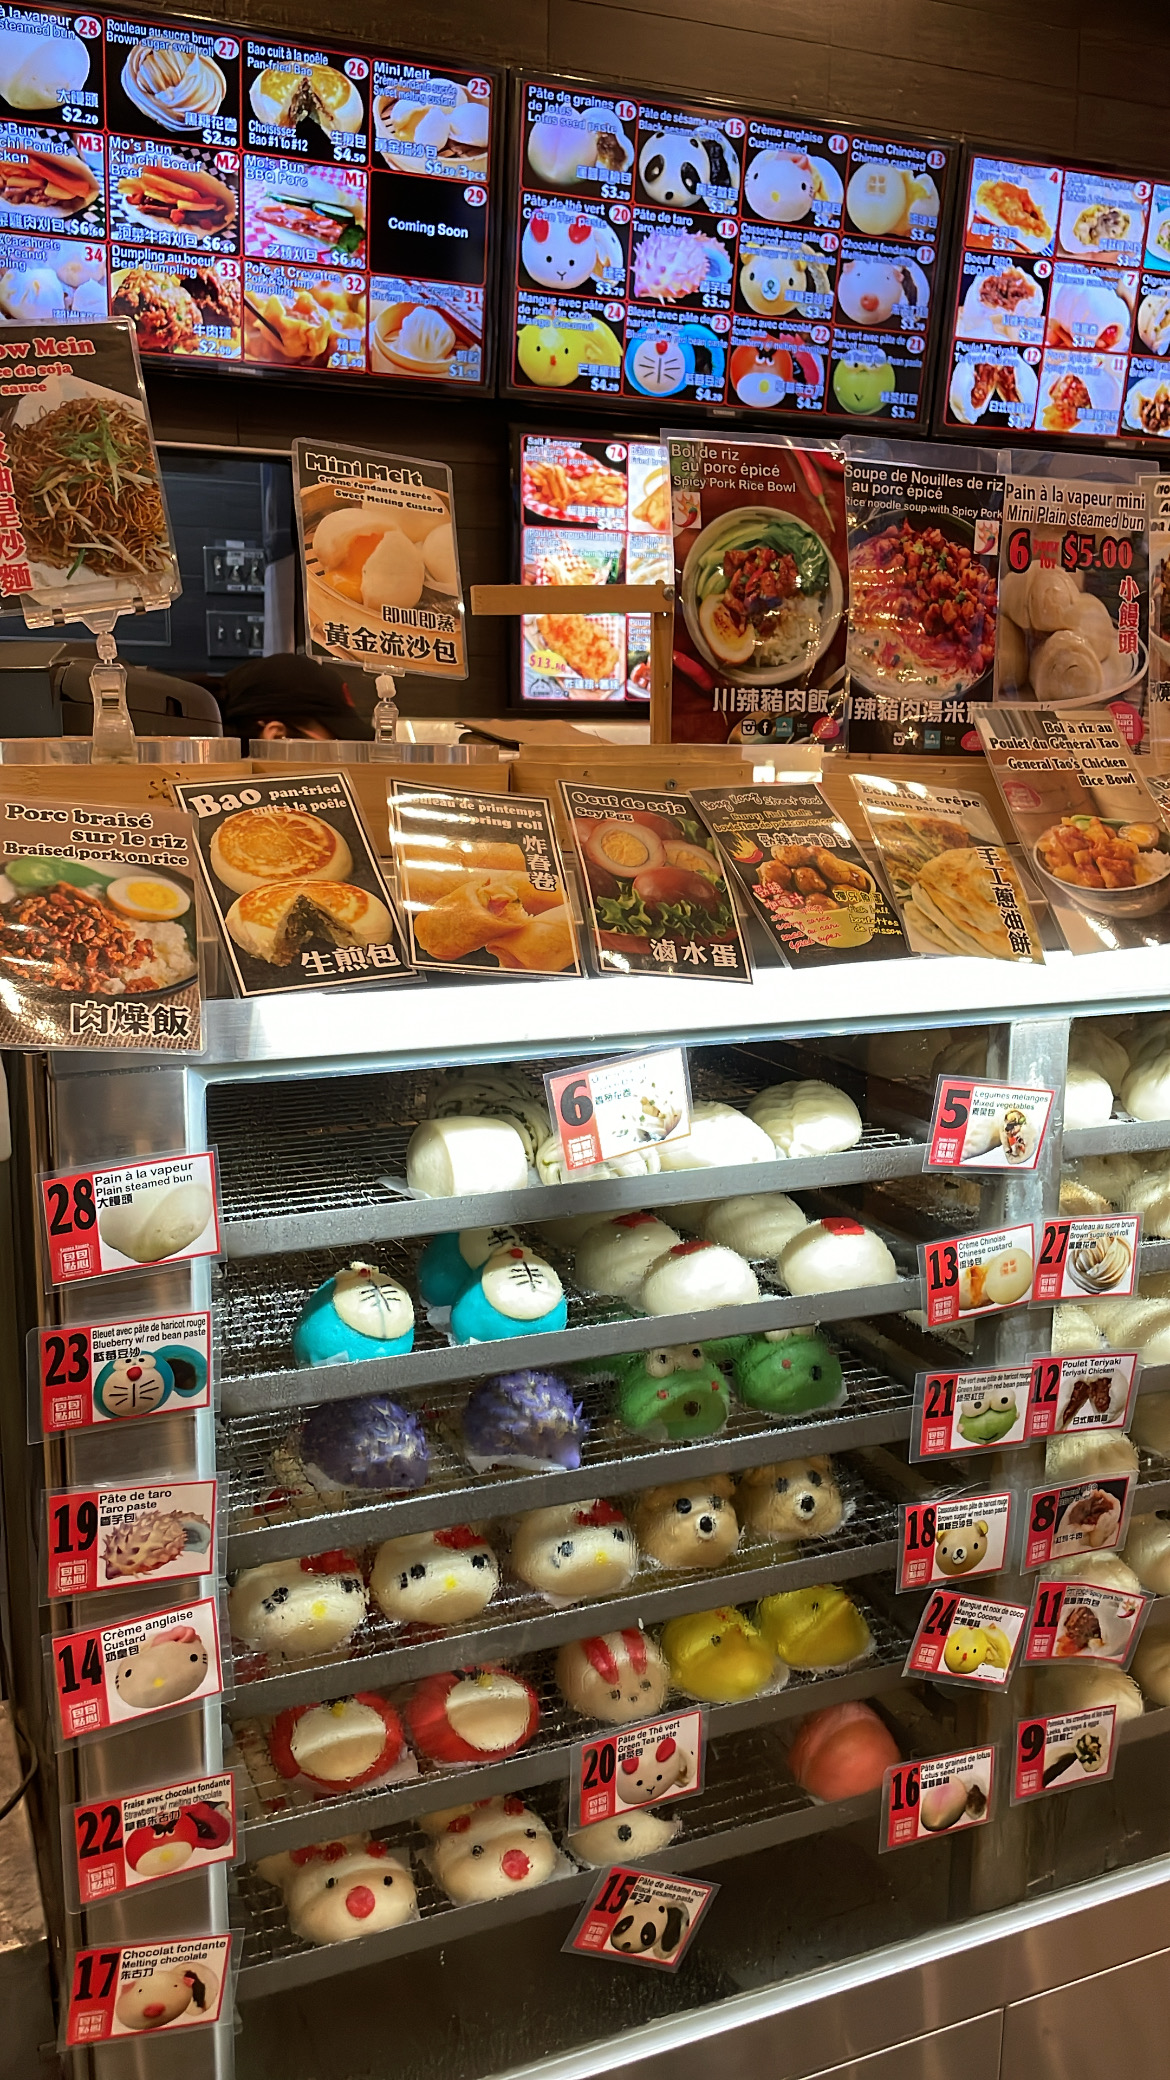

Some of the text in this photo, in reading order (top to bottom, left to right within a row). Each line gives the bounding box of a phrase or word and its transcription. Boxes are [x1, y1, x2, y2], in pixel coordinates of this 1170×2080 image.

[9, 7, 71, 28] la vapeur
[78, 19, 98, 36] 28
[107, 19, 213, 45] Rouleau au sucre brun
[218, 40, 235, 56] 27
[247, 58, 312, 76] Pan-fried Bao
[348, 62, 365, 77] 26
[374, 62, 430, 79] Mini Melt
[470, 81, 488, 95] 25
[529, 86, 614, 110] Pâte de graines
[62, 107, 98, 125] $2.20
[618, 103, 634, 118] 16
[202, 130, 237, 146] $2.50
[249, 120, 296, 138] Choisissez
[750, 123, 823, 144] Crème anglaise
[78, 135, 103, 152] M3
[109, 136, 172, 154] Mo's Bun
[832, 137, 845, 151] 14
[110, 151, 201, 172] Kimchi Boeuf
[216, 156, 239, 170] M2
[334, 147, 365, 163] $4.50
[929, 153, 943, 167] 13
[111, 165, 143, 177] Beef
[345, 172, 365, 187] M1
[467, 188, 483, 203] 29
[612, 207, 628, 222] 20
[388, 217, 469, 238] Coming Soon
[721, 221, 736, 237] 19
[85, 247, 103, 261] 34
[220, 262, 237, 277] 33
[346, 277, 362, 291] 32
[465, 290, 480, 304] 31
[607, 305, 621, 319] 24
[714, 317, 728, 331] 23
[814, 328, 828, 341] 22
[34, 337, 96, 356] Mein
[1, 382, 47, 394] sauce
[672, 444, 740, 461] Bol de riz
[305, 452, 423, 487] Mini Melt
[319, 475, 432, 501] Crème fondante sucrée
[674, 476, 796, 493] Spicy Pork Rice Bowl
[335, 489, 443, 514] Sweet Melting Custard
[867, 498, 1003, 519] noodle soup with Spicy Pork
[1007, 505, 1144, 531] Mini Plain steamed bun
[1008, 528, 1133, 573] 6 $5.00
[713, 687, 831, 714] 川辣豬肉飯
[1079, 773, 1135, 786] Rice Bowl
[188, 783, 342, 819] Bao pan-fried
[572, 792, 686, 815] Oeuf de soja
[866, 798, 962, 815] Scallion pancake
[936, 796, 980, 808] crêpe
[5, 803, 153, 829] Porc braisé
[575, 807, 634, 822] Soy Egg
[71, 830, 187, 850] sur le riz
[5, 842, 188, 866] Braised pork on rice
[522, 835, 558, 892] 炸春卷
[300, 943, 401, 977] 生煎包
[650, 938, 739, 968] 滷水蛋
[71, 1000, 191, 1039] 肉燥飯
[560, 1080, 594, 1126] 6
[940, 1089, 971, 1129] 5
[96, 1173, 193, 1197] Plain steamed bun
[47, 1179, 97, 1236] 28
[958, 1234, 1006, 1250] Crème Chinoise
[959, 1241, 1013, 1259] Chinese custard
[1040, 1225, 1071, 1264] 27
[929, 1247, 959, 1290] 13
[45, 1333, 89, 1387] 23
[1062, 1358, 1121, 1369] Poulet Teriyaki
[1062, 1367, 1115, 1378] Teriyaki Chicken
[1032, 1364, 1060, 1404] 12
[925, 1379, 954, 1419] 21
[99, 1490, 172, 1504] Pâte de taro
[100, 1501, 157, 1514] Taro paste
[1032, 1496, 1055, 1533] 8
[54, 1501, 98, 1554] 19
[907, 1507, 936, 1550] 18
[924, 1596, 957, 1636] 24
[1035, 1590, 1063, 1628] 11
[102, 1610, 193, 1642] Crème anglaise
[104, 1634, 147, 1652] Custard
[58, 1638, 102, 1694] 14
[617, 1742, 641, 1752] Green
[657, 1731, 677, 1743] paste
[1021, 1724, 1045, 1763] 9
[583, 1744, 615, 1790] 20
[123, 1778, 231, 1810] Fraise avec chocolat fondante
[892, 1768, 920, 1811] 16
[78, 1805, 123, 1860] 22
[594, 1874, 637, 1914] 15
[123, 1940, 226, 1960] Chocolat fondante
[122, 1952, 207, 1969] Melting chocolate
[75, 1953, 120, 2001] 17
